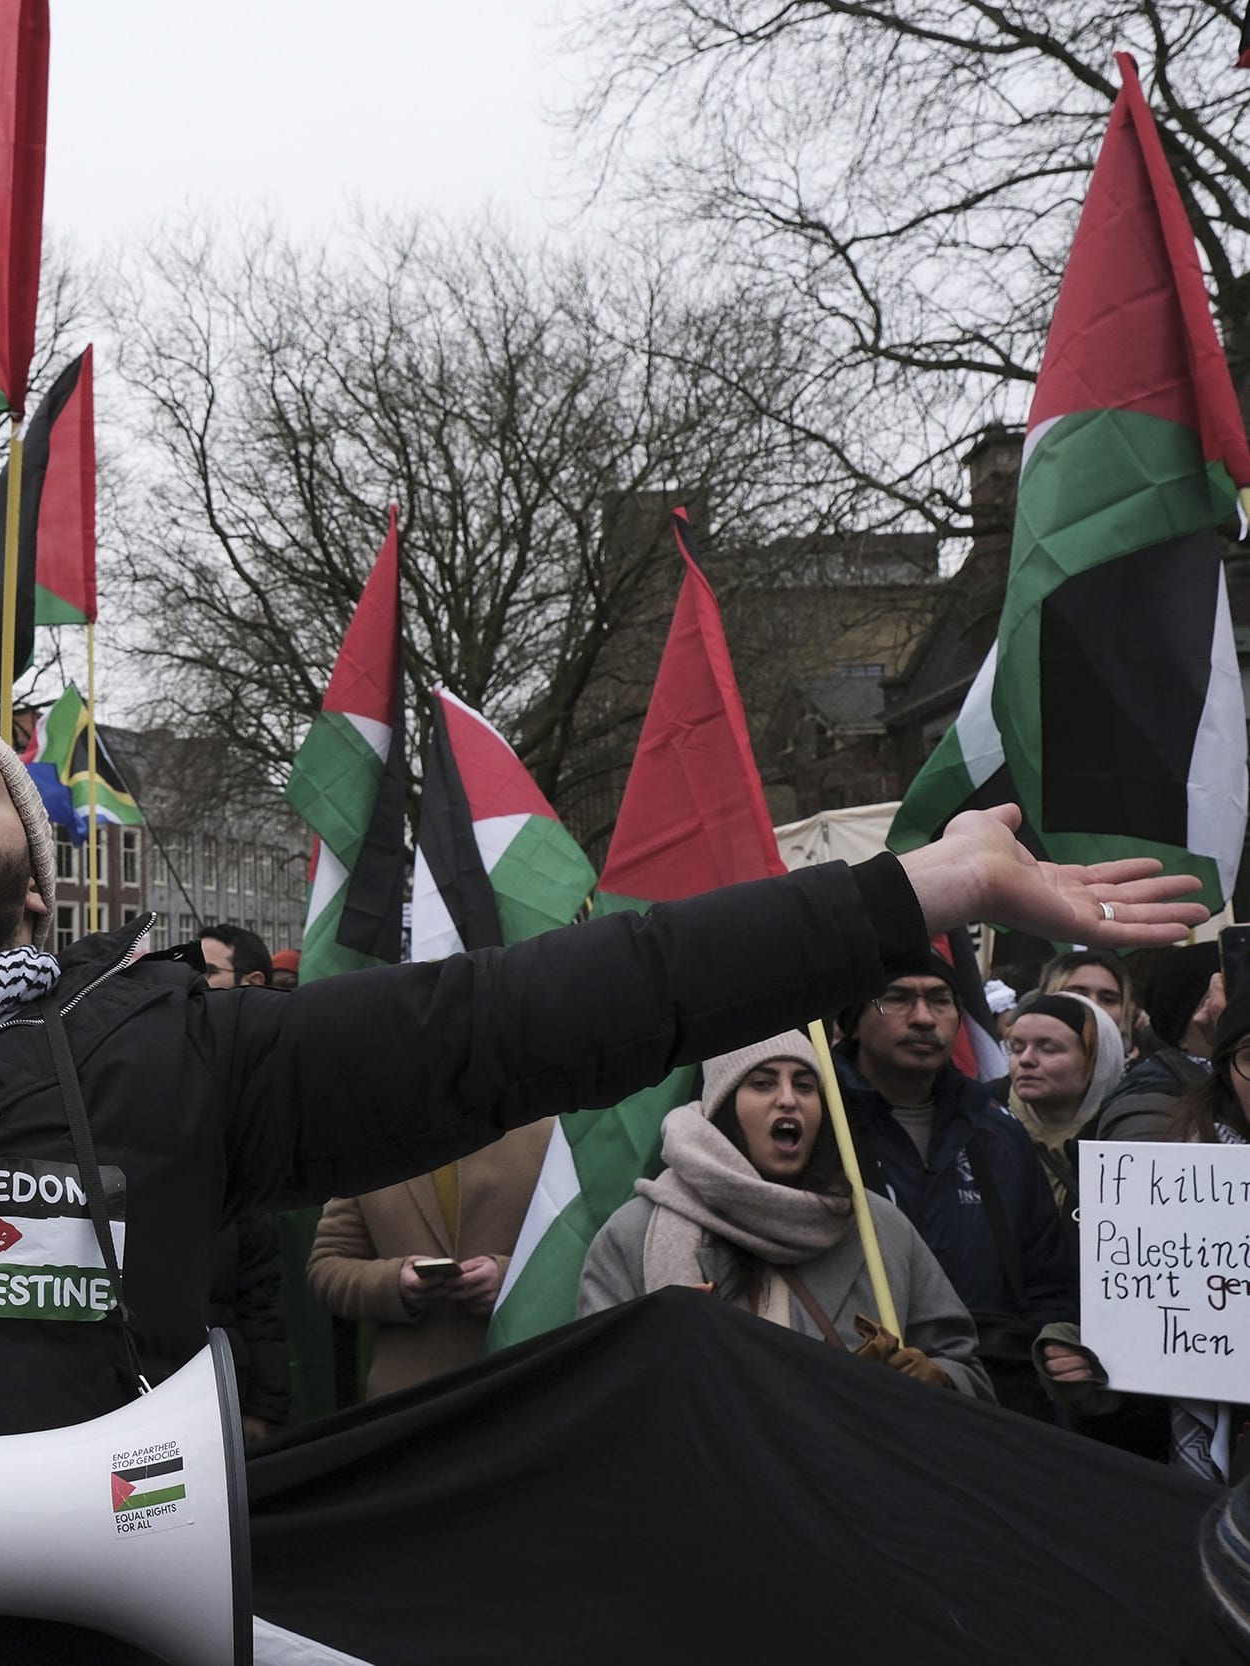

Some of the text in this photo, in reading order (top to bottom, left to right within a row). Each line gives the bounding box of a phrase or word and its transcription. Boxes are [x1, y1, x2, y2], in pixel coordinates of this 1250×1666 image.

[1101, 1270, 1180, 1300] isn't
[1157, 1305, 1235, 1356] Then
[112, 1441, 176, 1461] END APARTHEID
[112, 1448, 180, 1470] STOP GENOCIDE
[115, 1503, 177, 1524] EQUAL RIGHTS
[117, 1519, 152, 1534] FOR ALL
